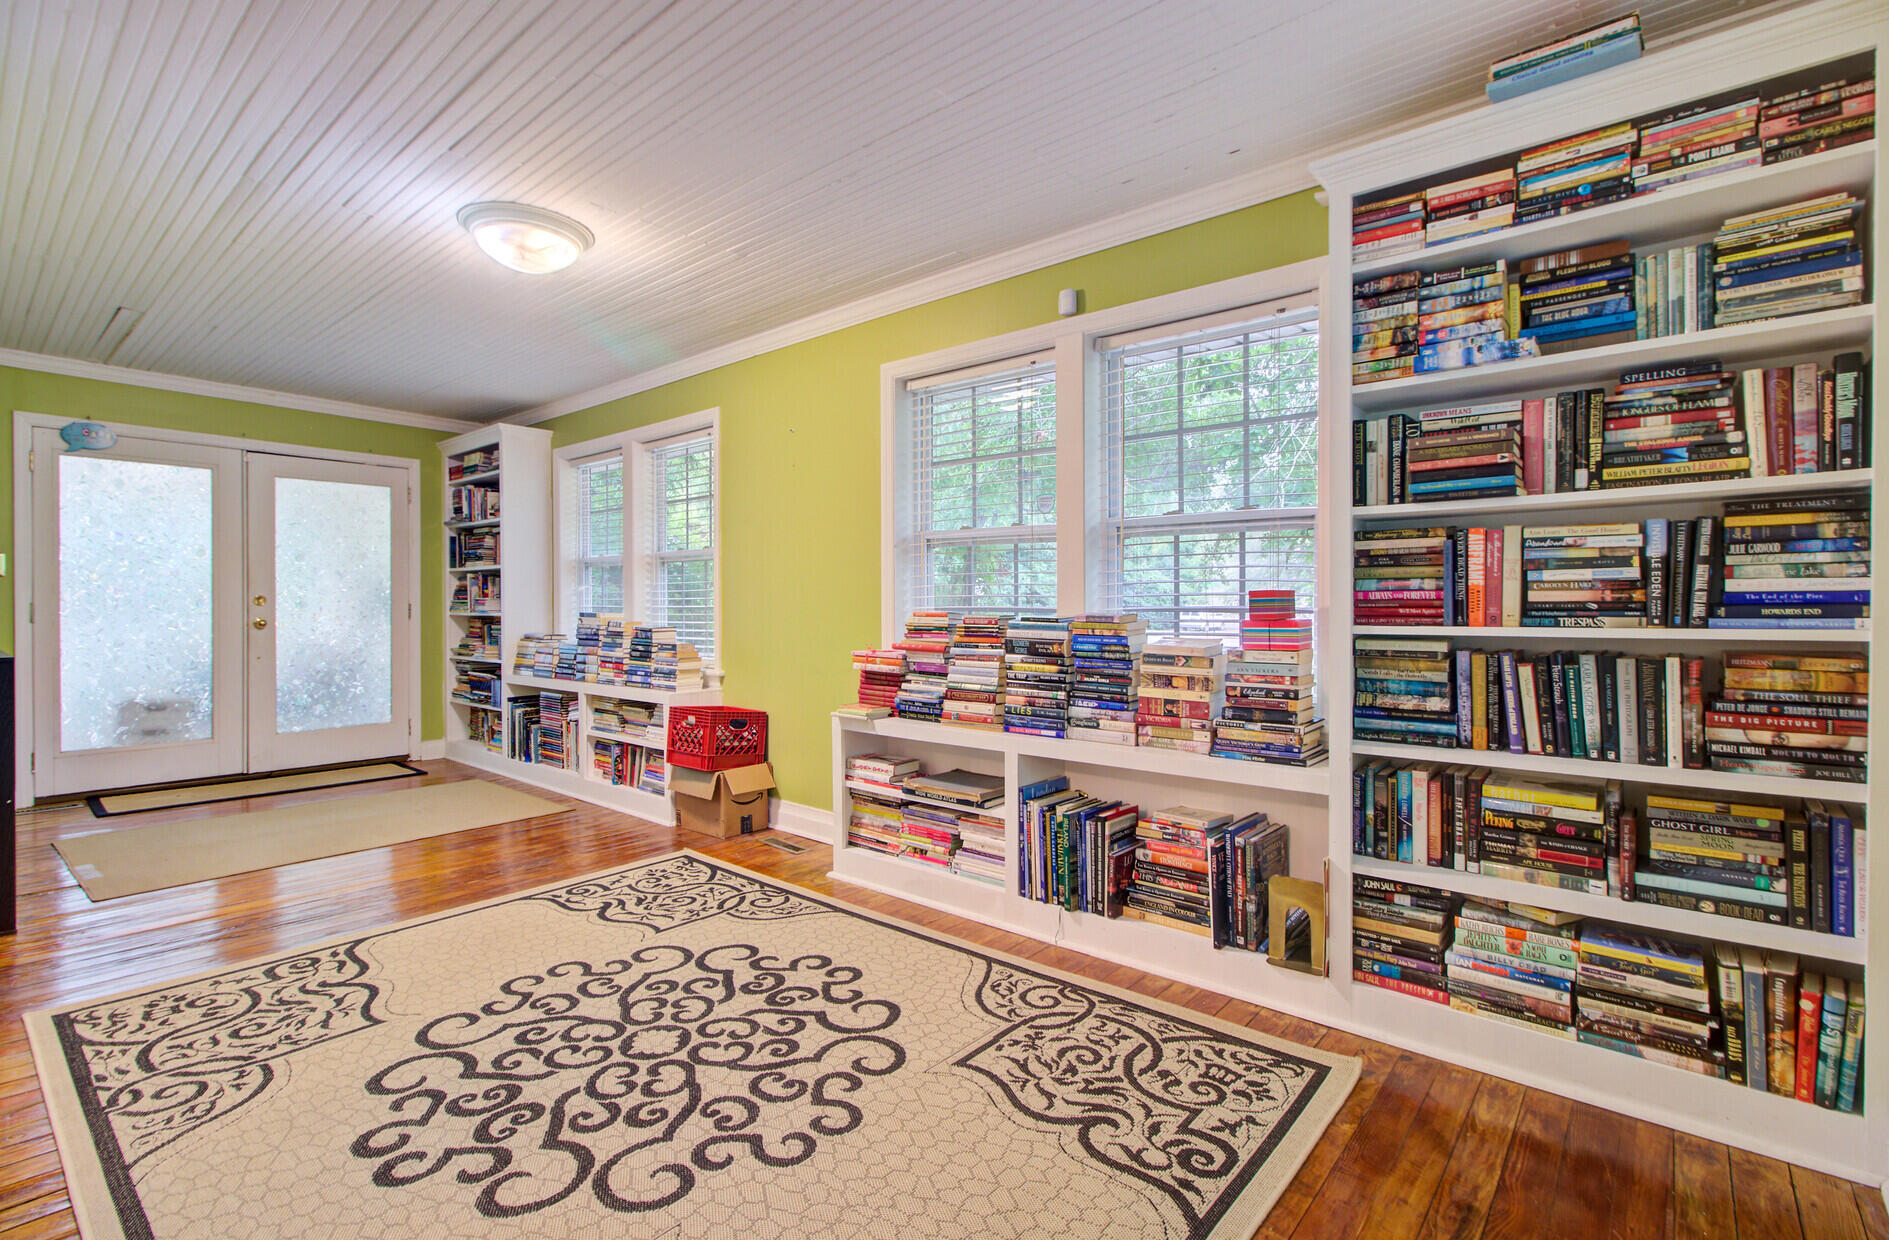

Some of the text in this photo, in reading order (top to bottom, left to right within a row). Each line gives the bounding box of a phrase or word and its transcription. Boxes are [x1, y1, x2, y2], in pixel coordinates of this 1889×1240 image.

[1624, 368, 1686, 384] SPELLING
[1392, 458, 1401, 496] CHAMBERLAIN
[1606, 460, 1729, 478] WILLIAM PETER BLATTY LEGION
[1776, 499, 1838, 508] TREATMENT
[1456, 532, 1464, 555] EVERY
[1650, 524, 1661, 570] INVISIBLE
[1728, 542, 1782, 554] JULIE GARWOOD
[1468, 534, 1485, 585] AIRFRAME
[1651, 571, 1662, 597] EDEN
[1404, 592, 1436, 600] FOREVER
[1559, 617, 1607, 627] TRESPASS
[1552, 665, 1563, 704] Peter Straub
[1752, 692, 1851, 704] THE SOUL THIEF
[1011, 706, 1032, 715] LIES
[1715, 703, 1868, 718] PETER DE JONGE SHADOWS STILL REMAIN
[1713, 715, 1734, 723] THE
[1766, 718, 1818, 728] PICTURE
[1711, 743, 1856, 762] MICHAEL KIMBALL MOUTH TO MOUTH
[1833, 771, 1850, 779] HILL
[1455, 797, 1463, 818] FIFTY
[1651, 819, 1730, 835] GHOST GIRL
[1793, 862, 1806, 875] THE
[1362, 880, 1396, 891] JOHN SAUL
[1144, 901, 1168, 911] ENGLAND
[1744, 906, 1765, 922] DEAD
[1459, 919, 1479, 932] KATHY
[1480, 924, 1505, 935] REICHS
[1528, 933, 1546, 943] BARE
[1547, 936, 1570, 948] BONES
[1525, 943, 1547, 953] NAOMI
[1525, 948, 1547, 961] RAGEN
[1455, 957, 1510, 977] IAN RANKIN
[1487, 954, 1547, 973] BILLY DEAD
